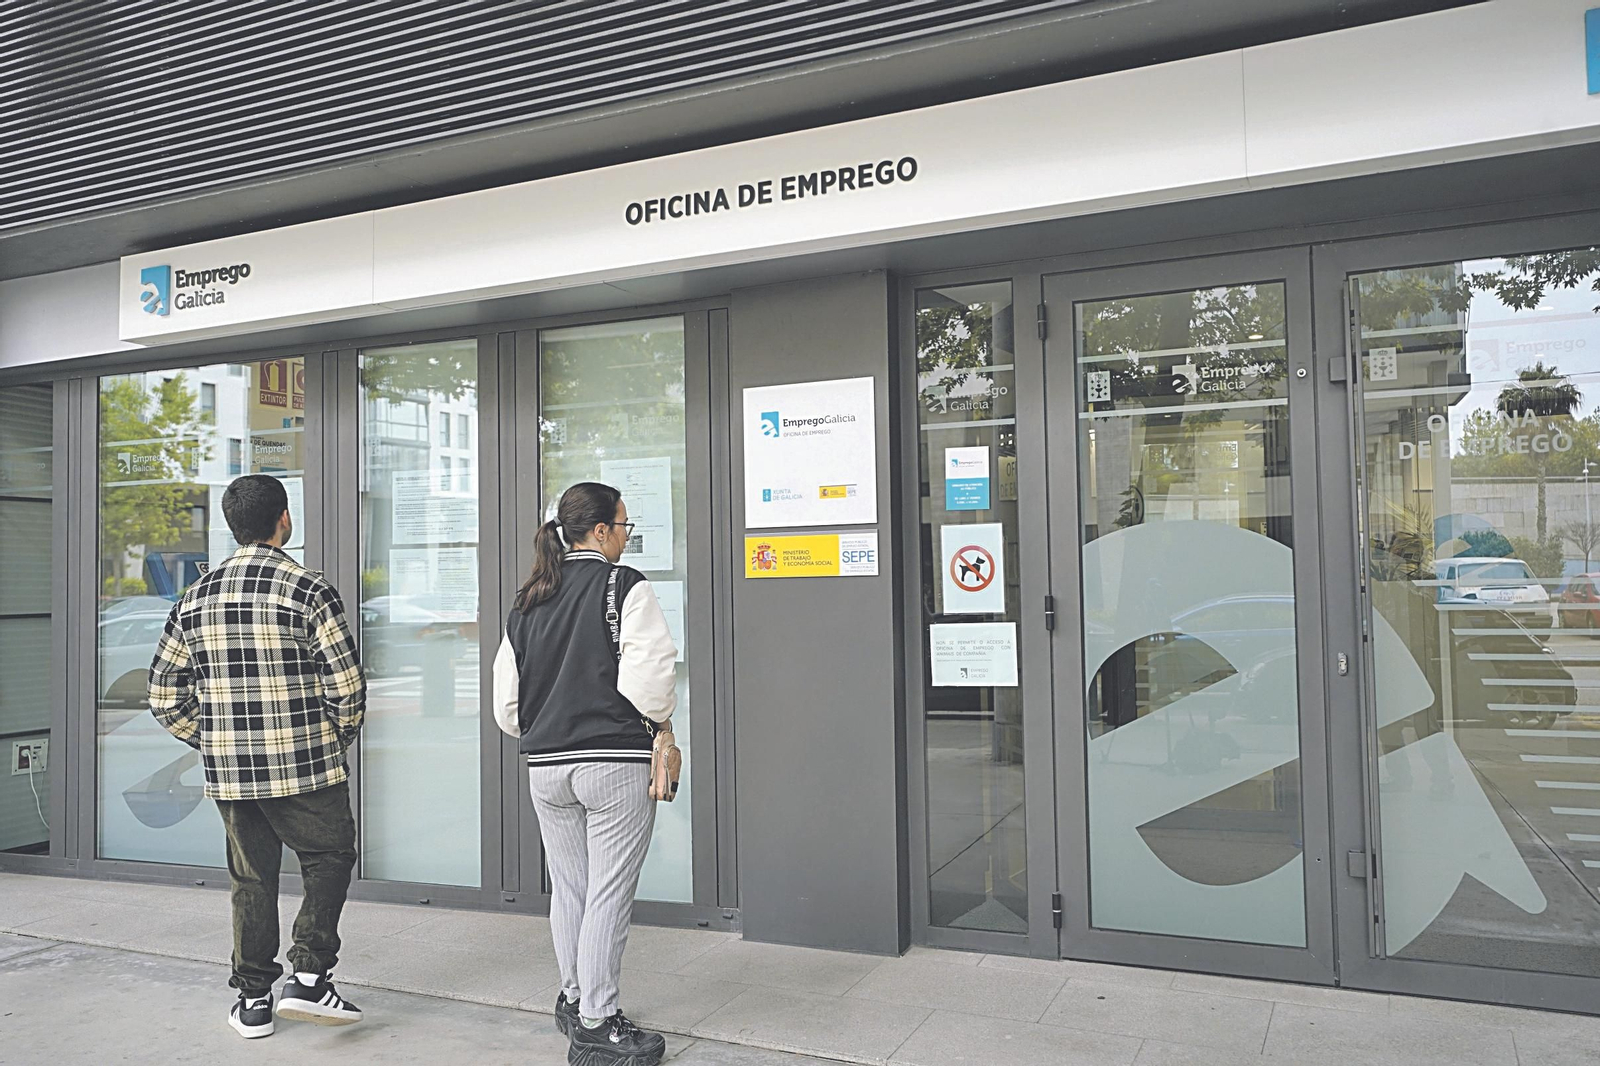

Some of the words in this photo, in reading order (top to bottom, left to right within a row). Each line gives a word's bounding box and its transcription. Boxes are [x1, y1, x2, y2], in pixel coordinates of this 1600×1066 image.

[625, 188, 730, 225] OFICINA
[738, 180, 773, 207] DE
[781, 156, 918, 201] EMPREGO
[175, 263, 250, 289] Emprego
[175, 288, 225, 310] Galicia
[1505, 338, 1587, 354] Emprego
[1200, 364, 1267, 379] Emprego
[1201, 379, 1246, 392] Galicia
[260, 393, 286, 405] EXTINTOR
[950, 400, 989, 411] Galicia
[632, 414, 680, 425] Emprego
[783, 414, 856, 427] EmpregoGalicia
[255, 444, 292, 455] Emprego
[1399, 440, 1431, 460] DE
[255, 455, 280, 464] Galicia
[132, 465, 155, 473] Galicia
[842, 550, 875, 563] SEPE
[607, 590, 616, 613] BIMBA
